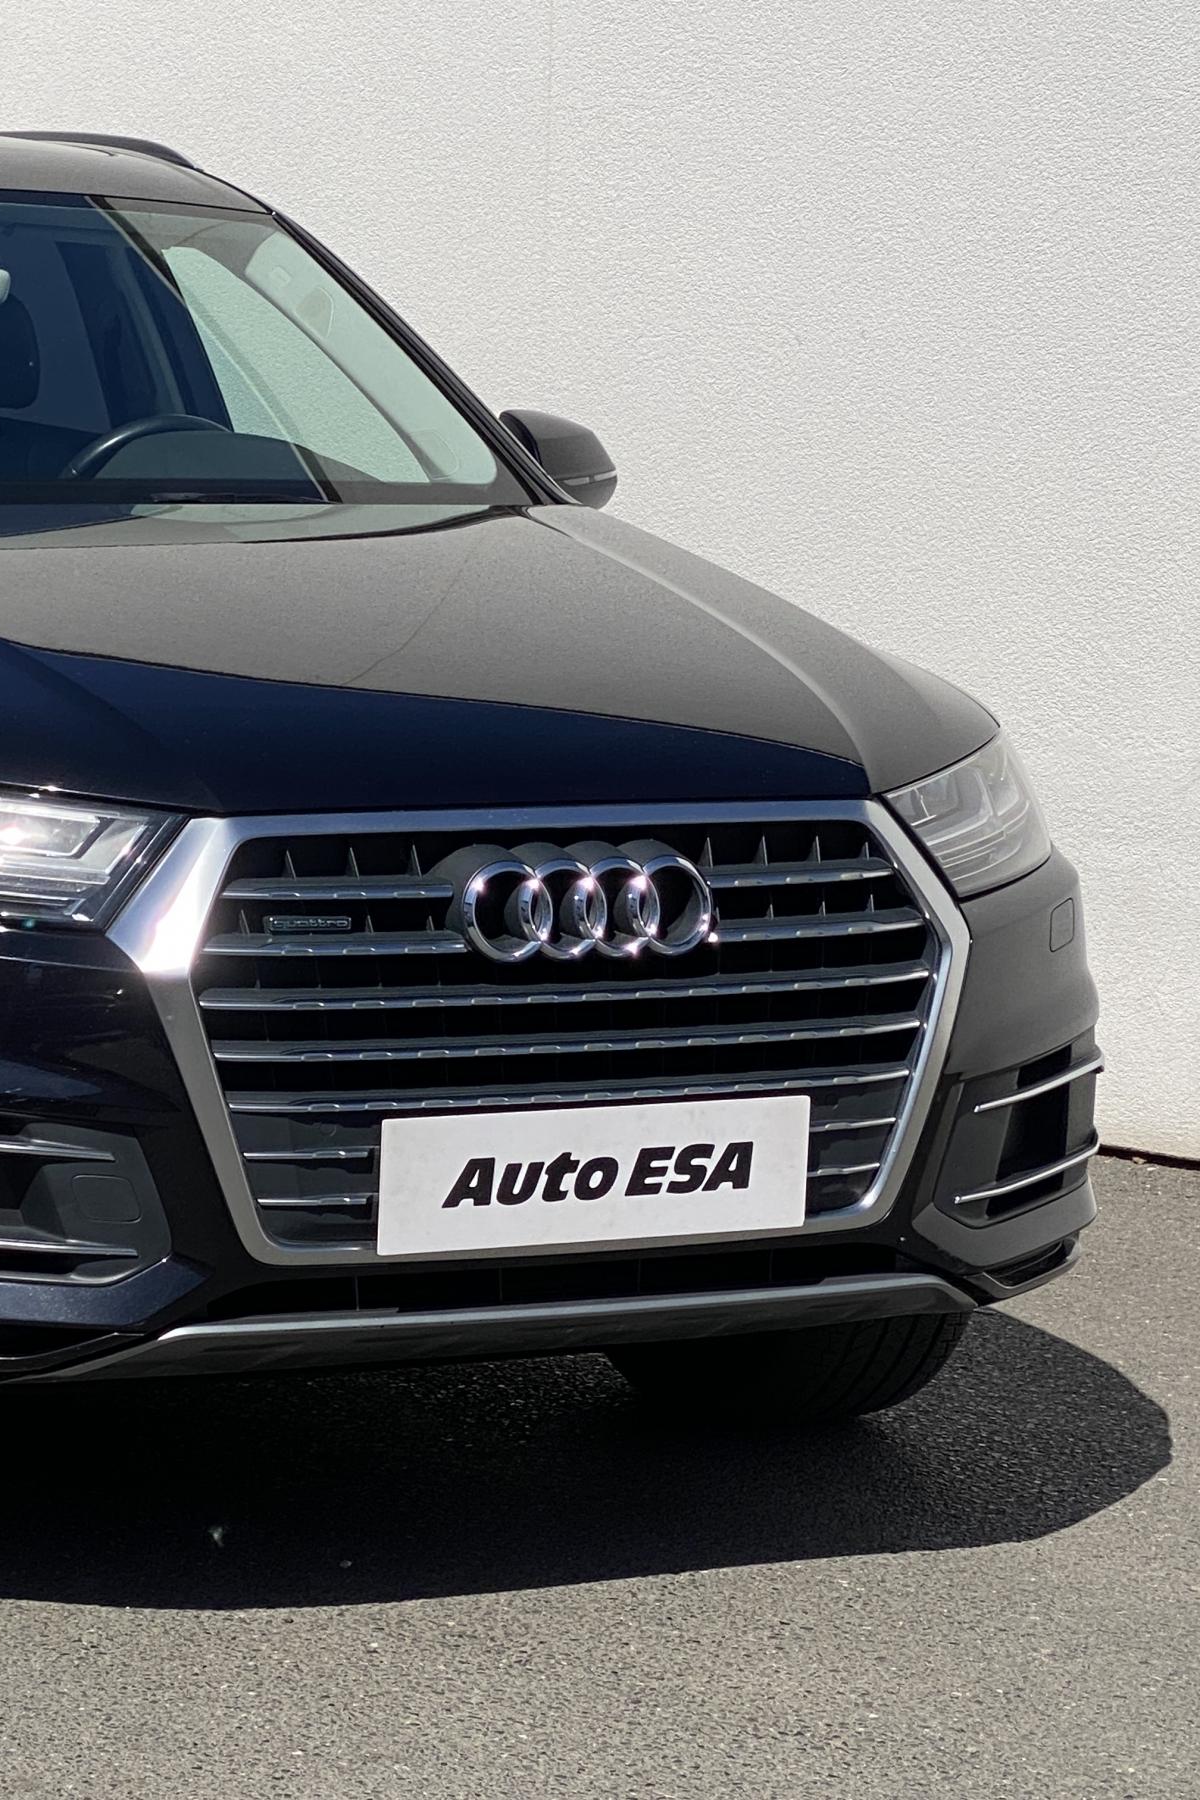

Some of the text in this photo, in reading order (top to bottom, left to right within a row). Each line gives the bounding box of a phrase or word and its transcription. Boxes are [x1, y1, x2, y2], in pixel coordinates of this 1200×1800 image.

[273, 919, 348, 929] quattro
[441, 1141, 754, 1209] Auto ESA
